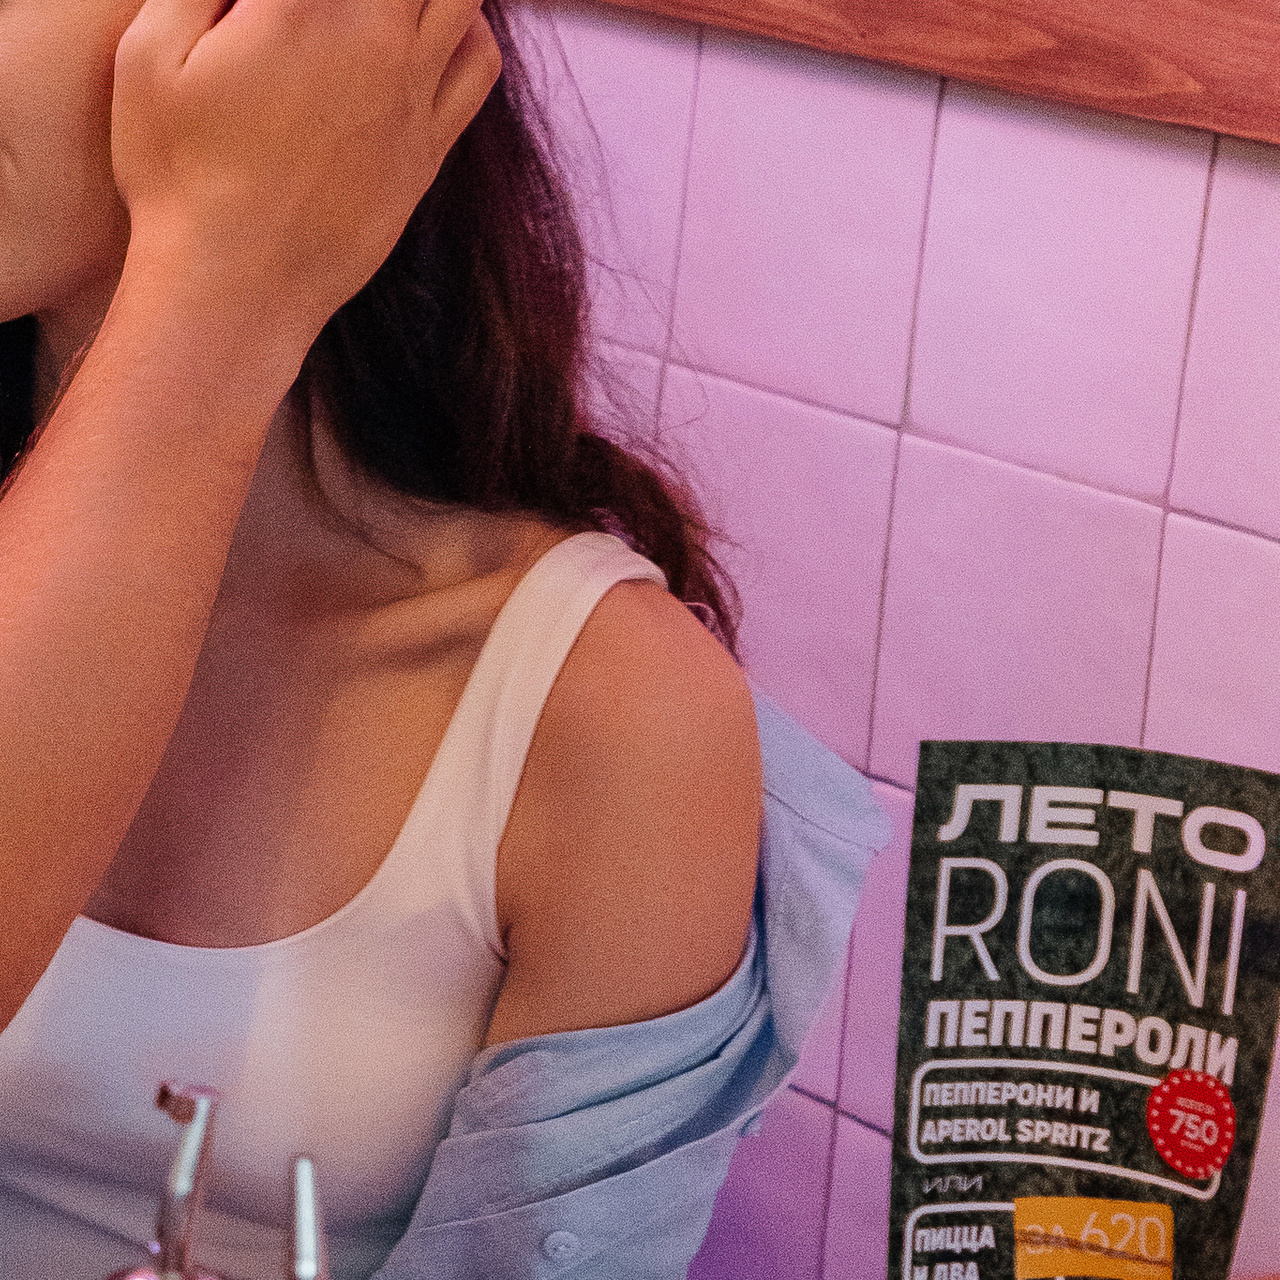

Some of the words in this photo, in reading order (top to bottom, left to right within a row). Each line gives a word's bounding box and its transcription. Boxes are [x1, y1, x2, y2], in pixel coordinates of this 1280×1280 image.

[936, 783, 1266, 872] ЛЕТО
[928, 856, 1248, 1017] RONI
[923, 999, 1239, 1086] ПЕППЕРОЛИ
[923, 1081, 1075, 1109] ПЕППЕРОНИ
[1078, 1088, 1100, 1114] И
[920, 1118, 1012, 1144] APEROL
[1015, 1121, 1111, 1153] SPRITZ
[1167, 1107, 1219, 1147] 750
[913, 1224, 997, 1254] ПИЦЦА
[1079, 1210, 1168, 1261] 620
